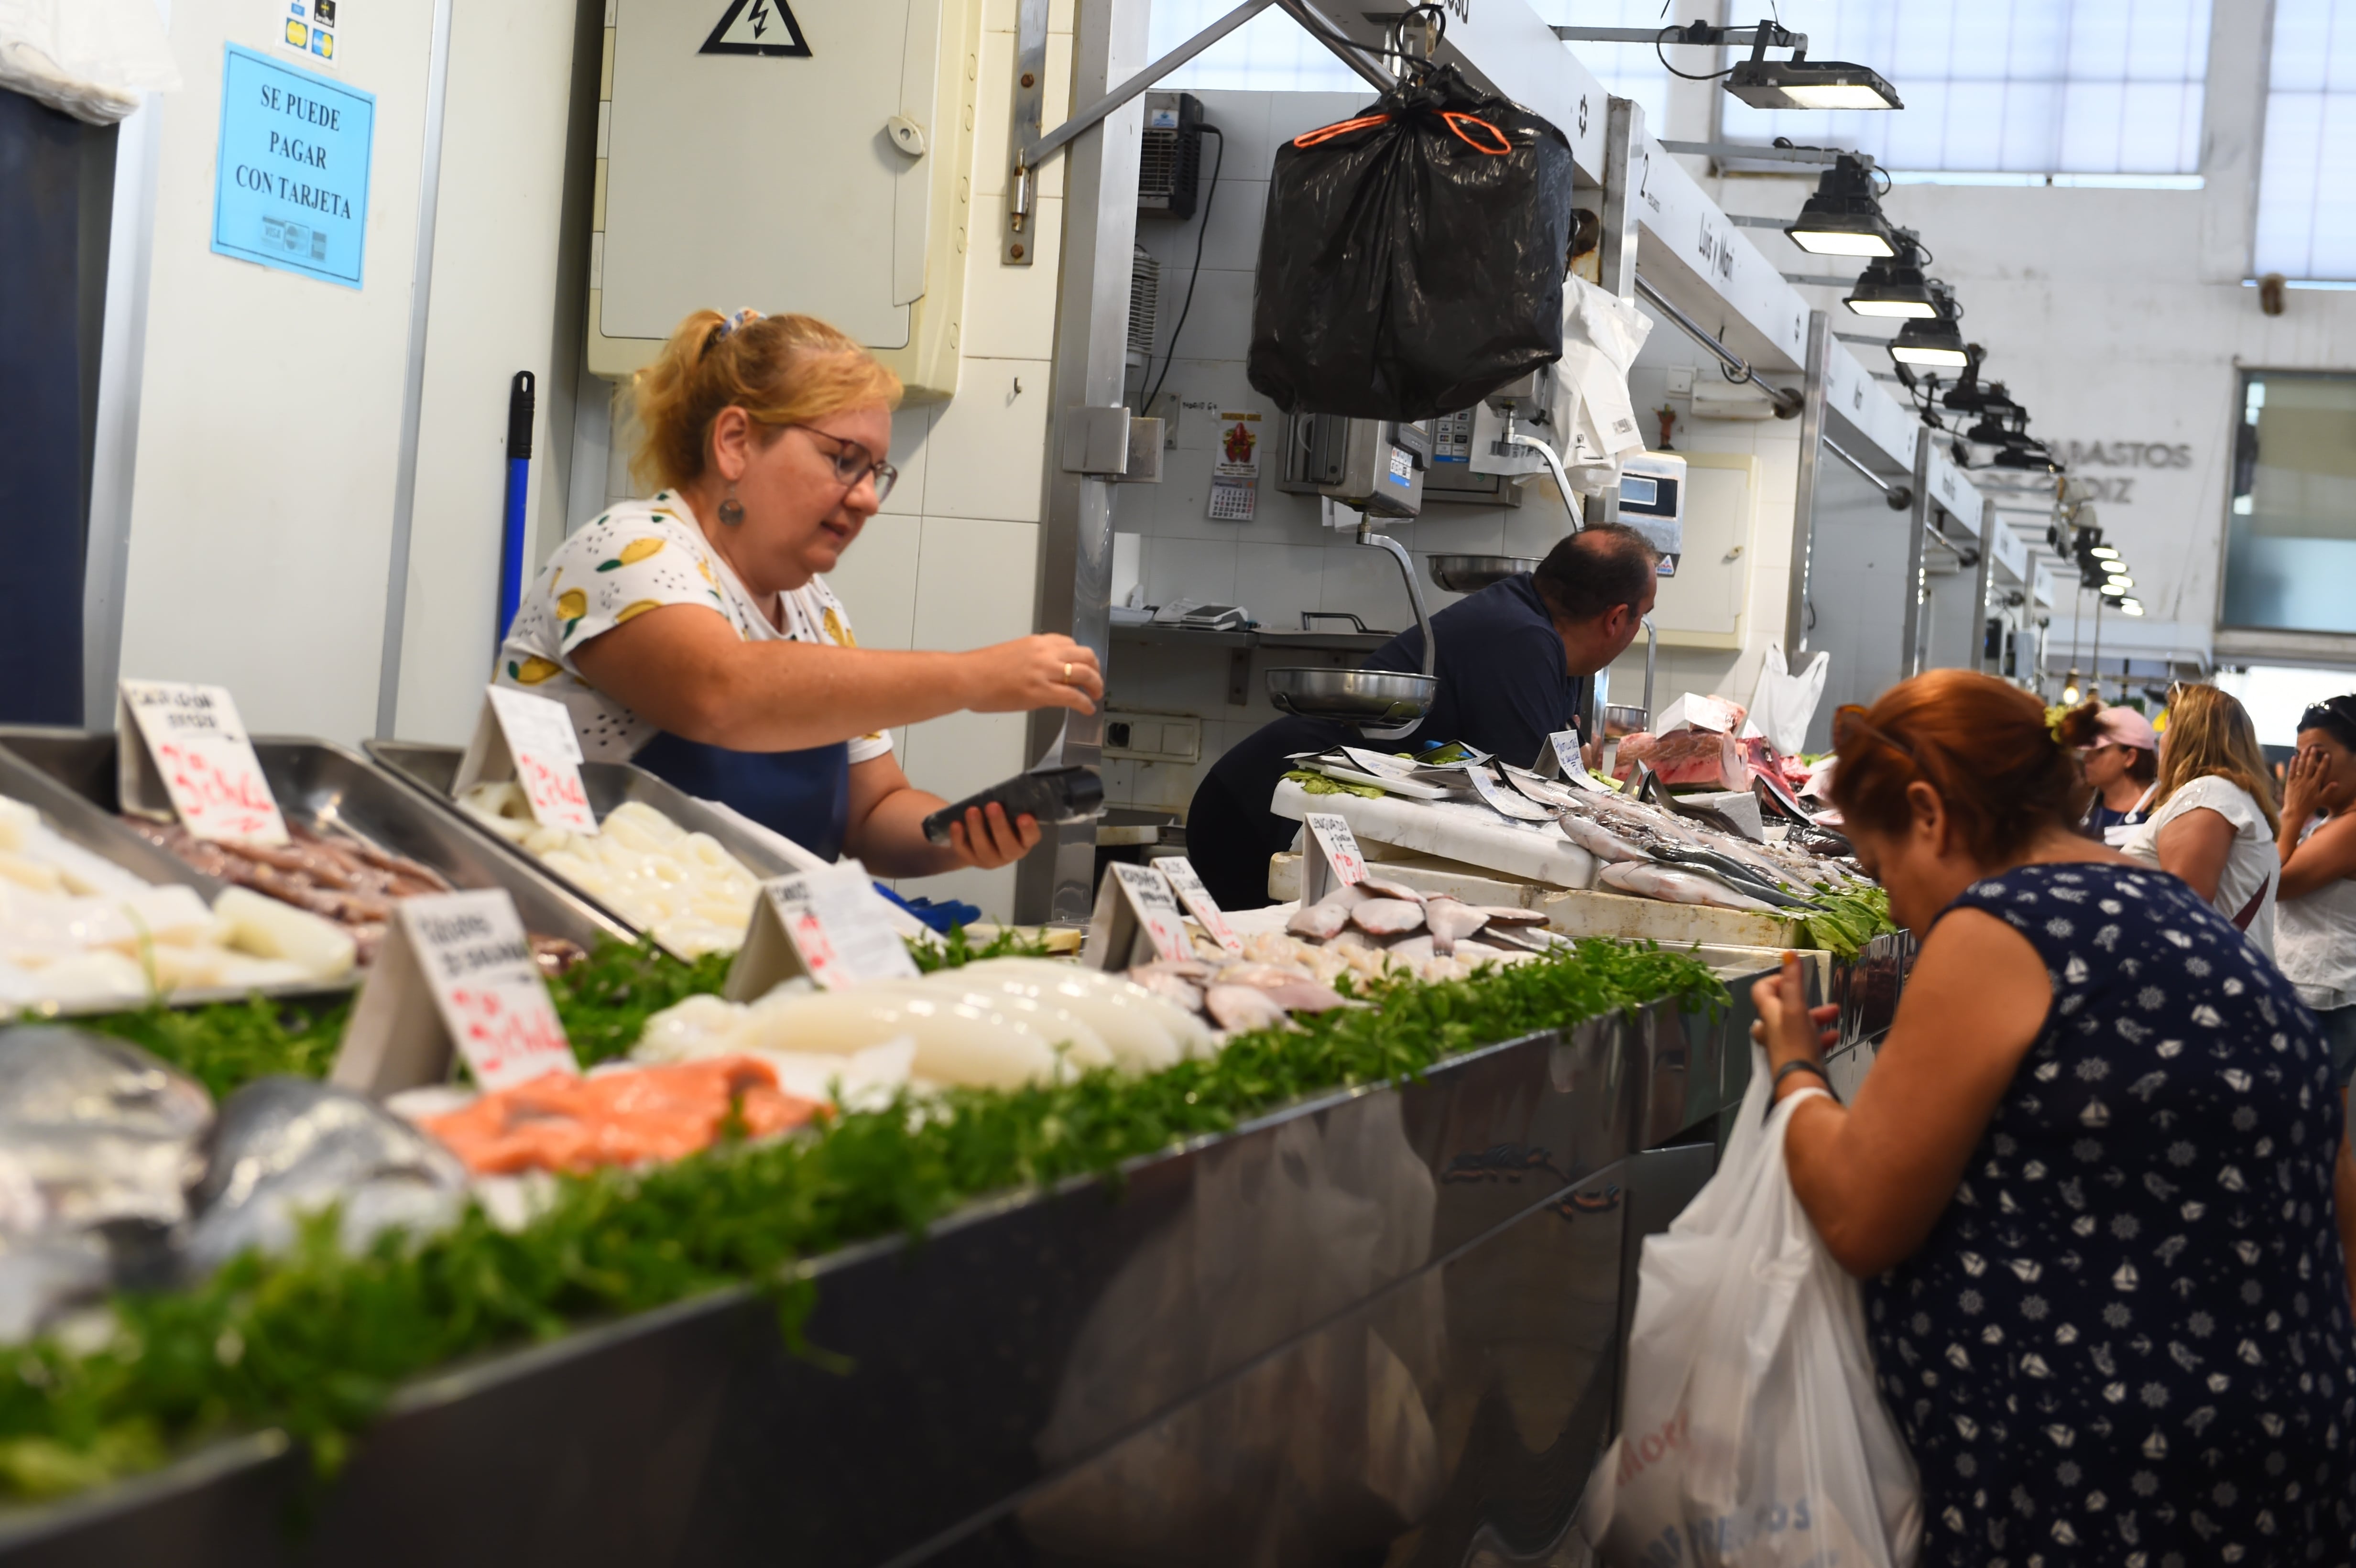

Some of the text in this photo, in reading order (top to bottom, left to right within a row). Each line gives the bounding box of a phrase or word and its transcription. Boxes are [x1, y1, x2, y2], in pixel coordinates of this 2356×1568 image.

[261, 84, 340, 131] SE PUEDE
[270, 131, 327, 170] PAGAR
[236, 164, 351, 219] CON TARJETA
[1640, 152, 1649, 198] 2
[1699, 212, 1712, 262] Luis
[1711, 240, 1718, 276] y
